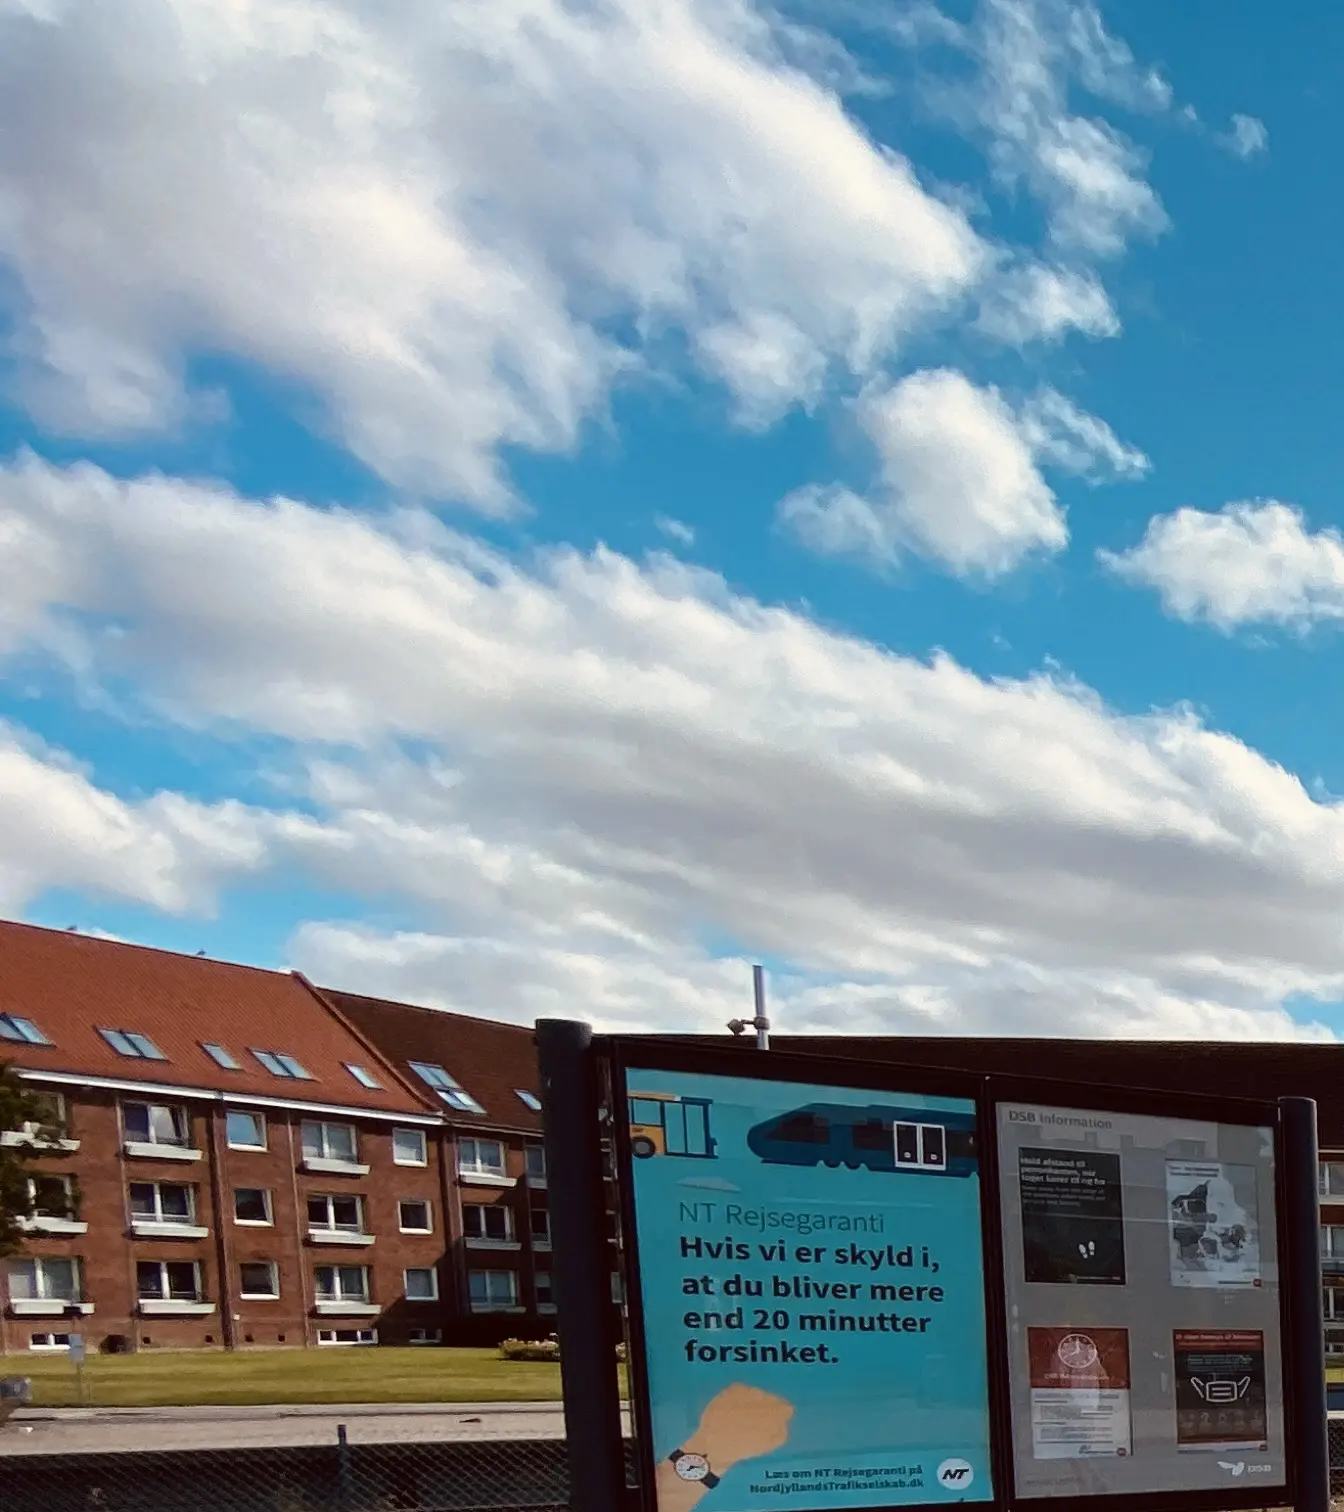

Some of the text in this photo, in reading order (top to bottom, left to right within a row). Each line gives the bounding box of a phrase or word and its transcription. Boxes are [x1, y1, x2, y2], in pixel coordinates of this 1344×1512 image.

[1009, 1110, 1036, 1122] DSB
[679, 1202, 884, 1234] NT Rejsegaranti
[680, 1236, 940, 1273] Hvis vi er skyld i,
[682, 1274, 944, 1302] at du bliver mere
[683, 1306, 932, 1332] end 20 minutter
[684, 1338, 839, 1364] forsinket.
[765, 1464, 923, 1480] Læs om NT Rejsegaranti på
[942, 1468, 970, 1480] NT
[750, 1478, 924, 1494] NordjyllandsTrafikselskab.dk
